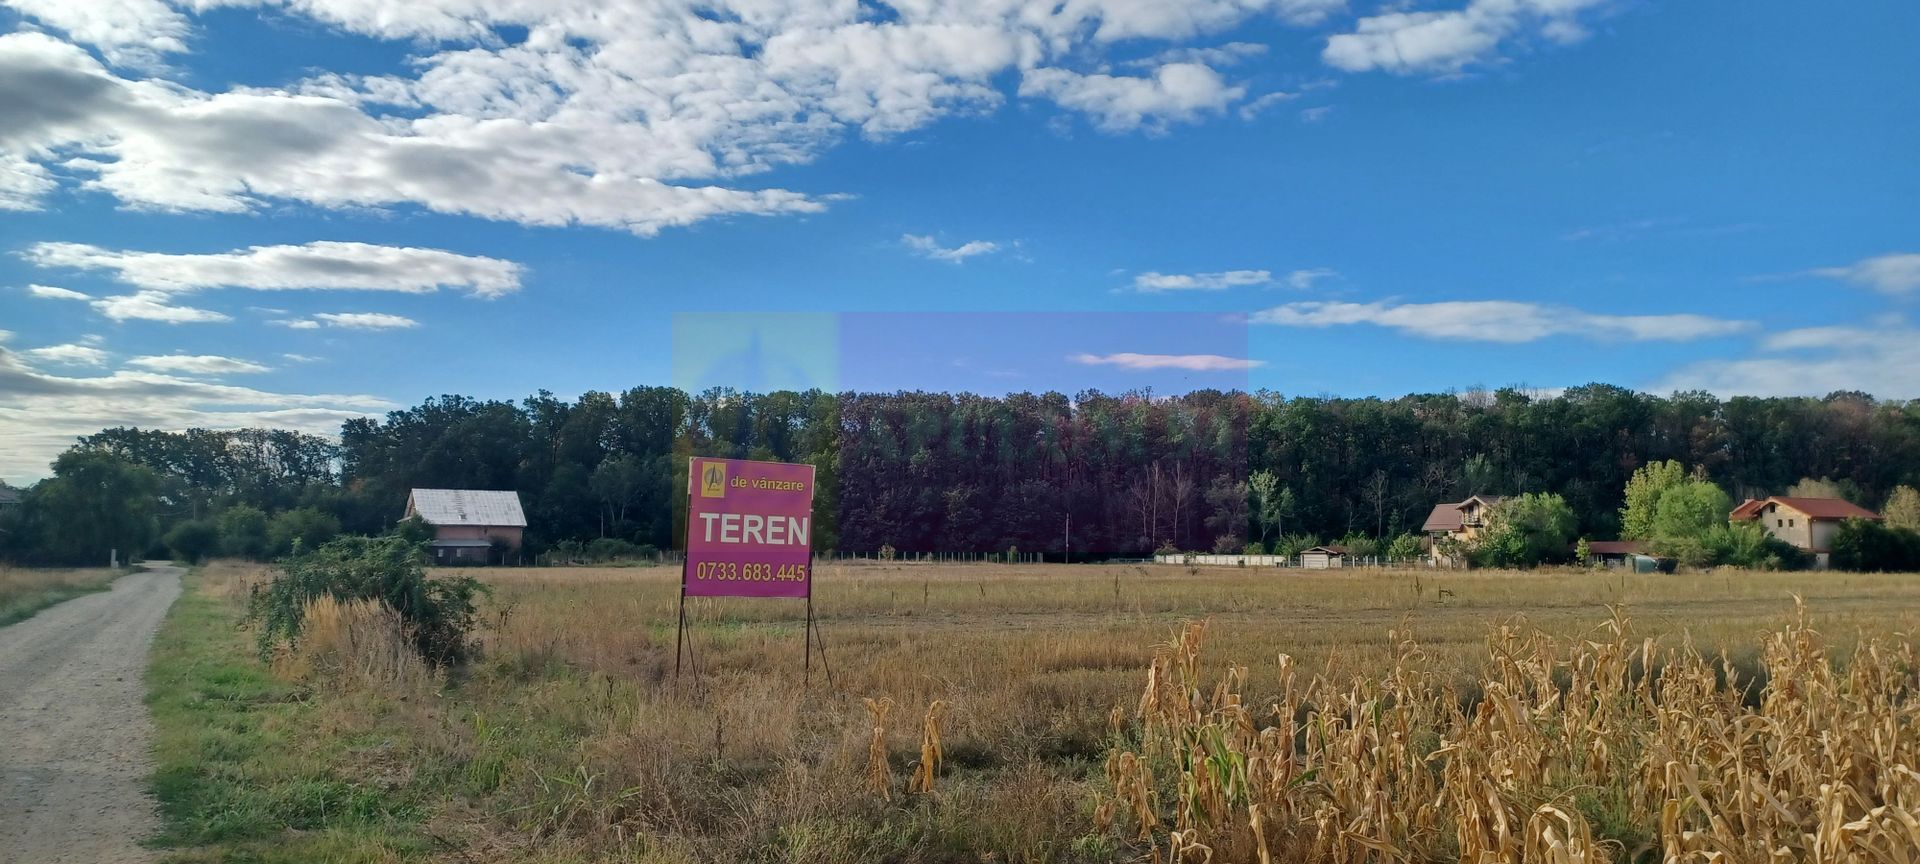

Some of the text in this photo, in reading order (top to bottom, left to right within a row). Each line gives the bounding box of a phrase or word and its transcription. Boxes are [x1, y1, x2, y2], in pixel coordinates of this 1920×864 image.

[730, 475, 805, 491] de vânzare
[699, 512, 808, 546] TEREN
[696, 561, 806, 582] 0733.683.445
